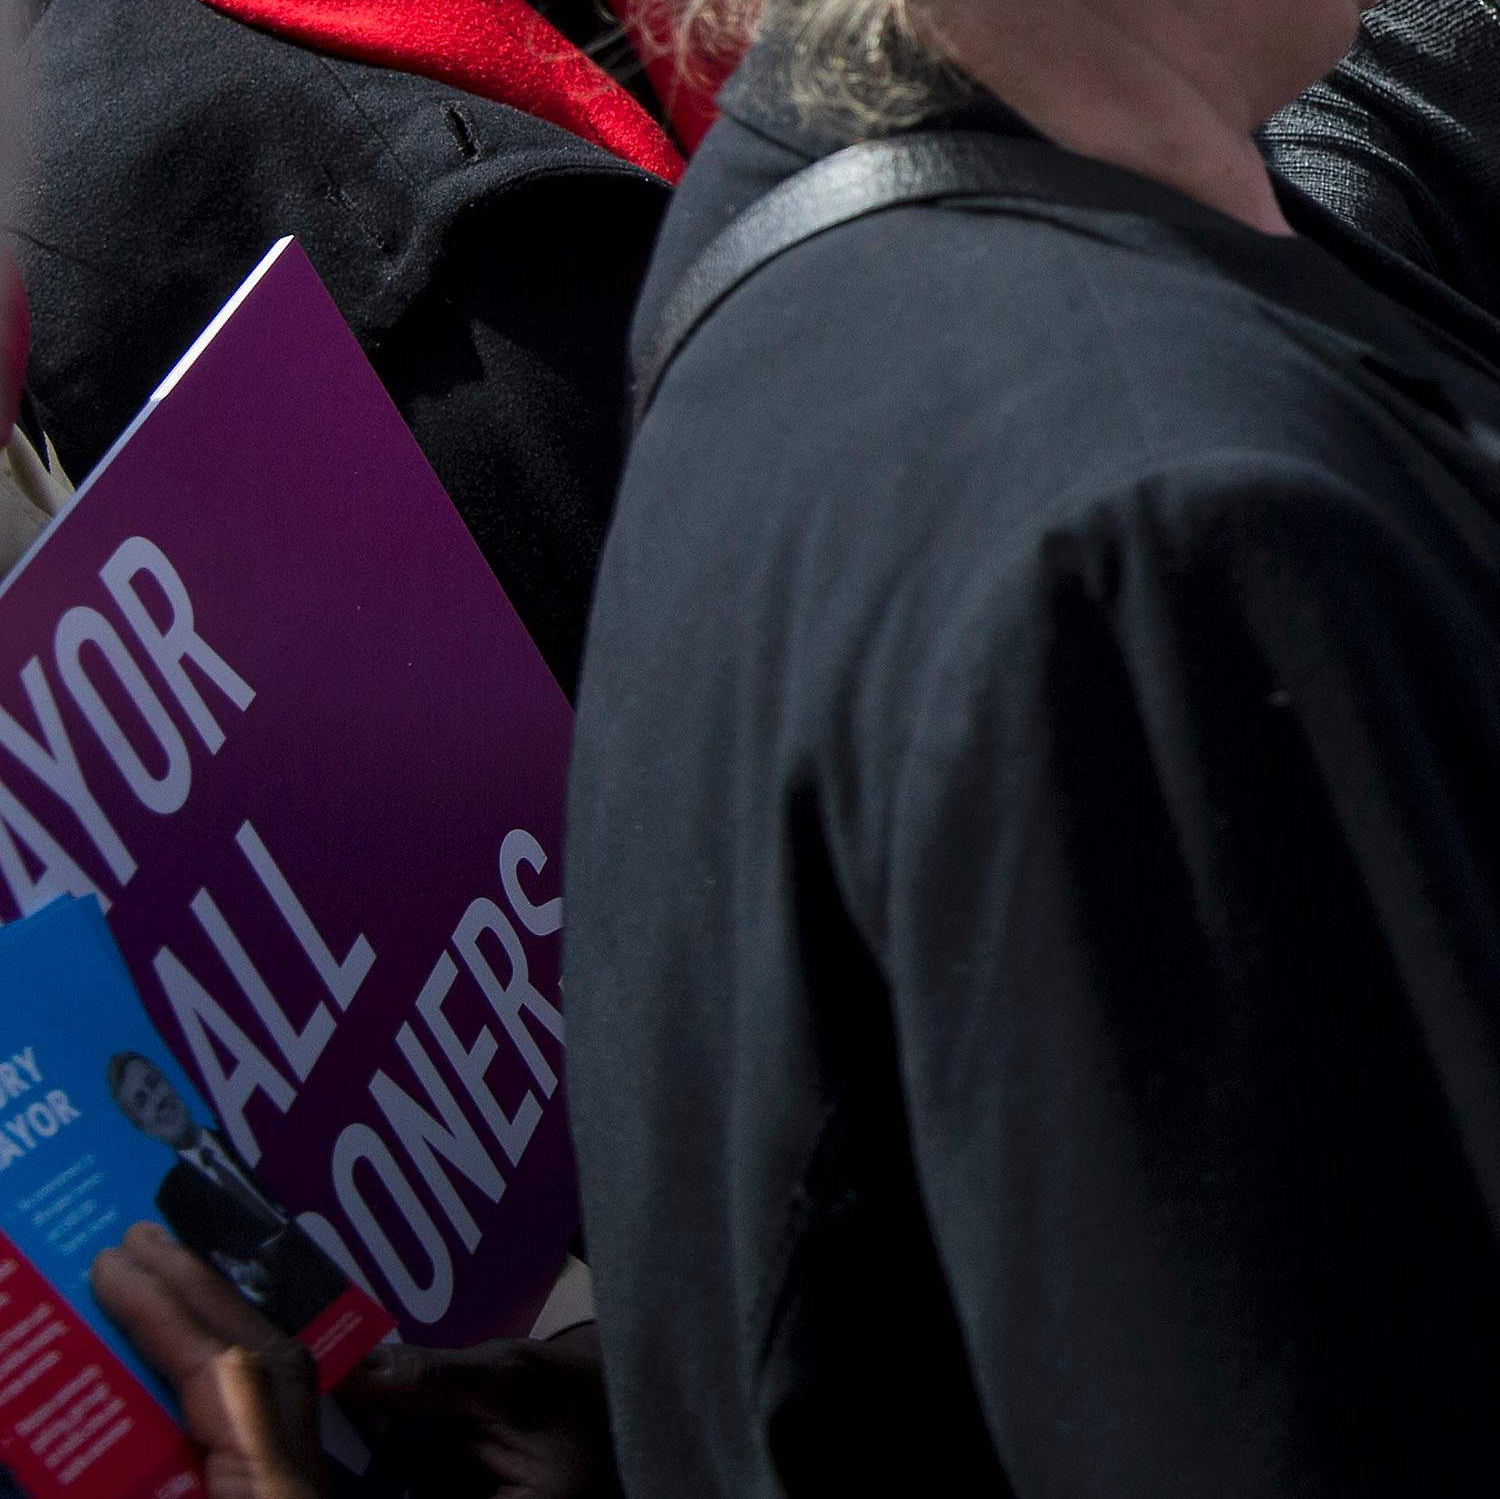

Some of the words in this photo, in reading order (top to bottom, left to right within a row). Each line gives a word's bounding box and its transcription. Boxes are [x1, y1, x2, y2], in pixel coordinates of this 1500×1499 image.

[0, 535, 257, 920] AYOR
[0, 1088, 82, 1172] AYOR
[151, 818, 377, 1168] ALL
[296, 828, 564, 1324] ONERS
